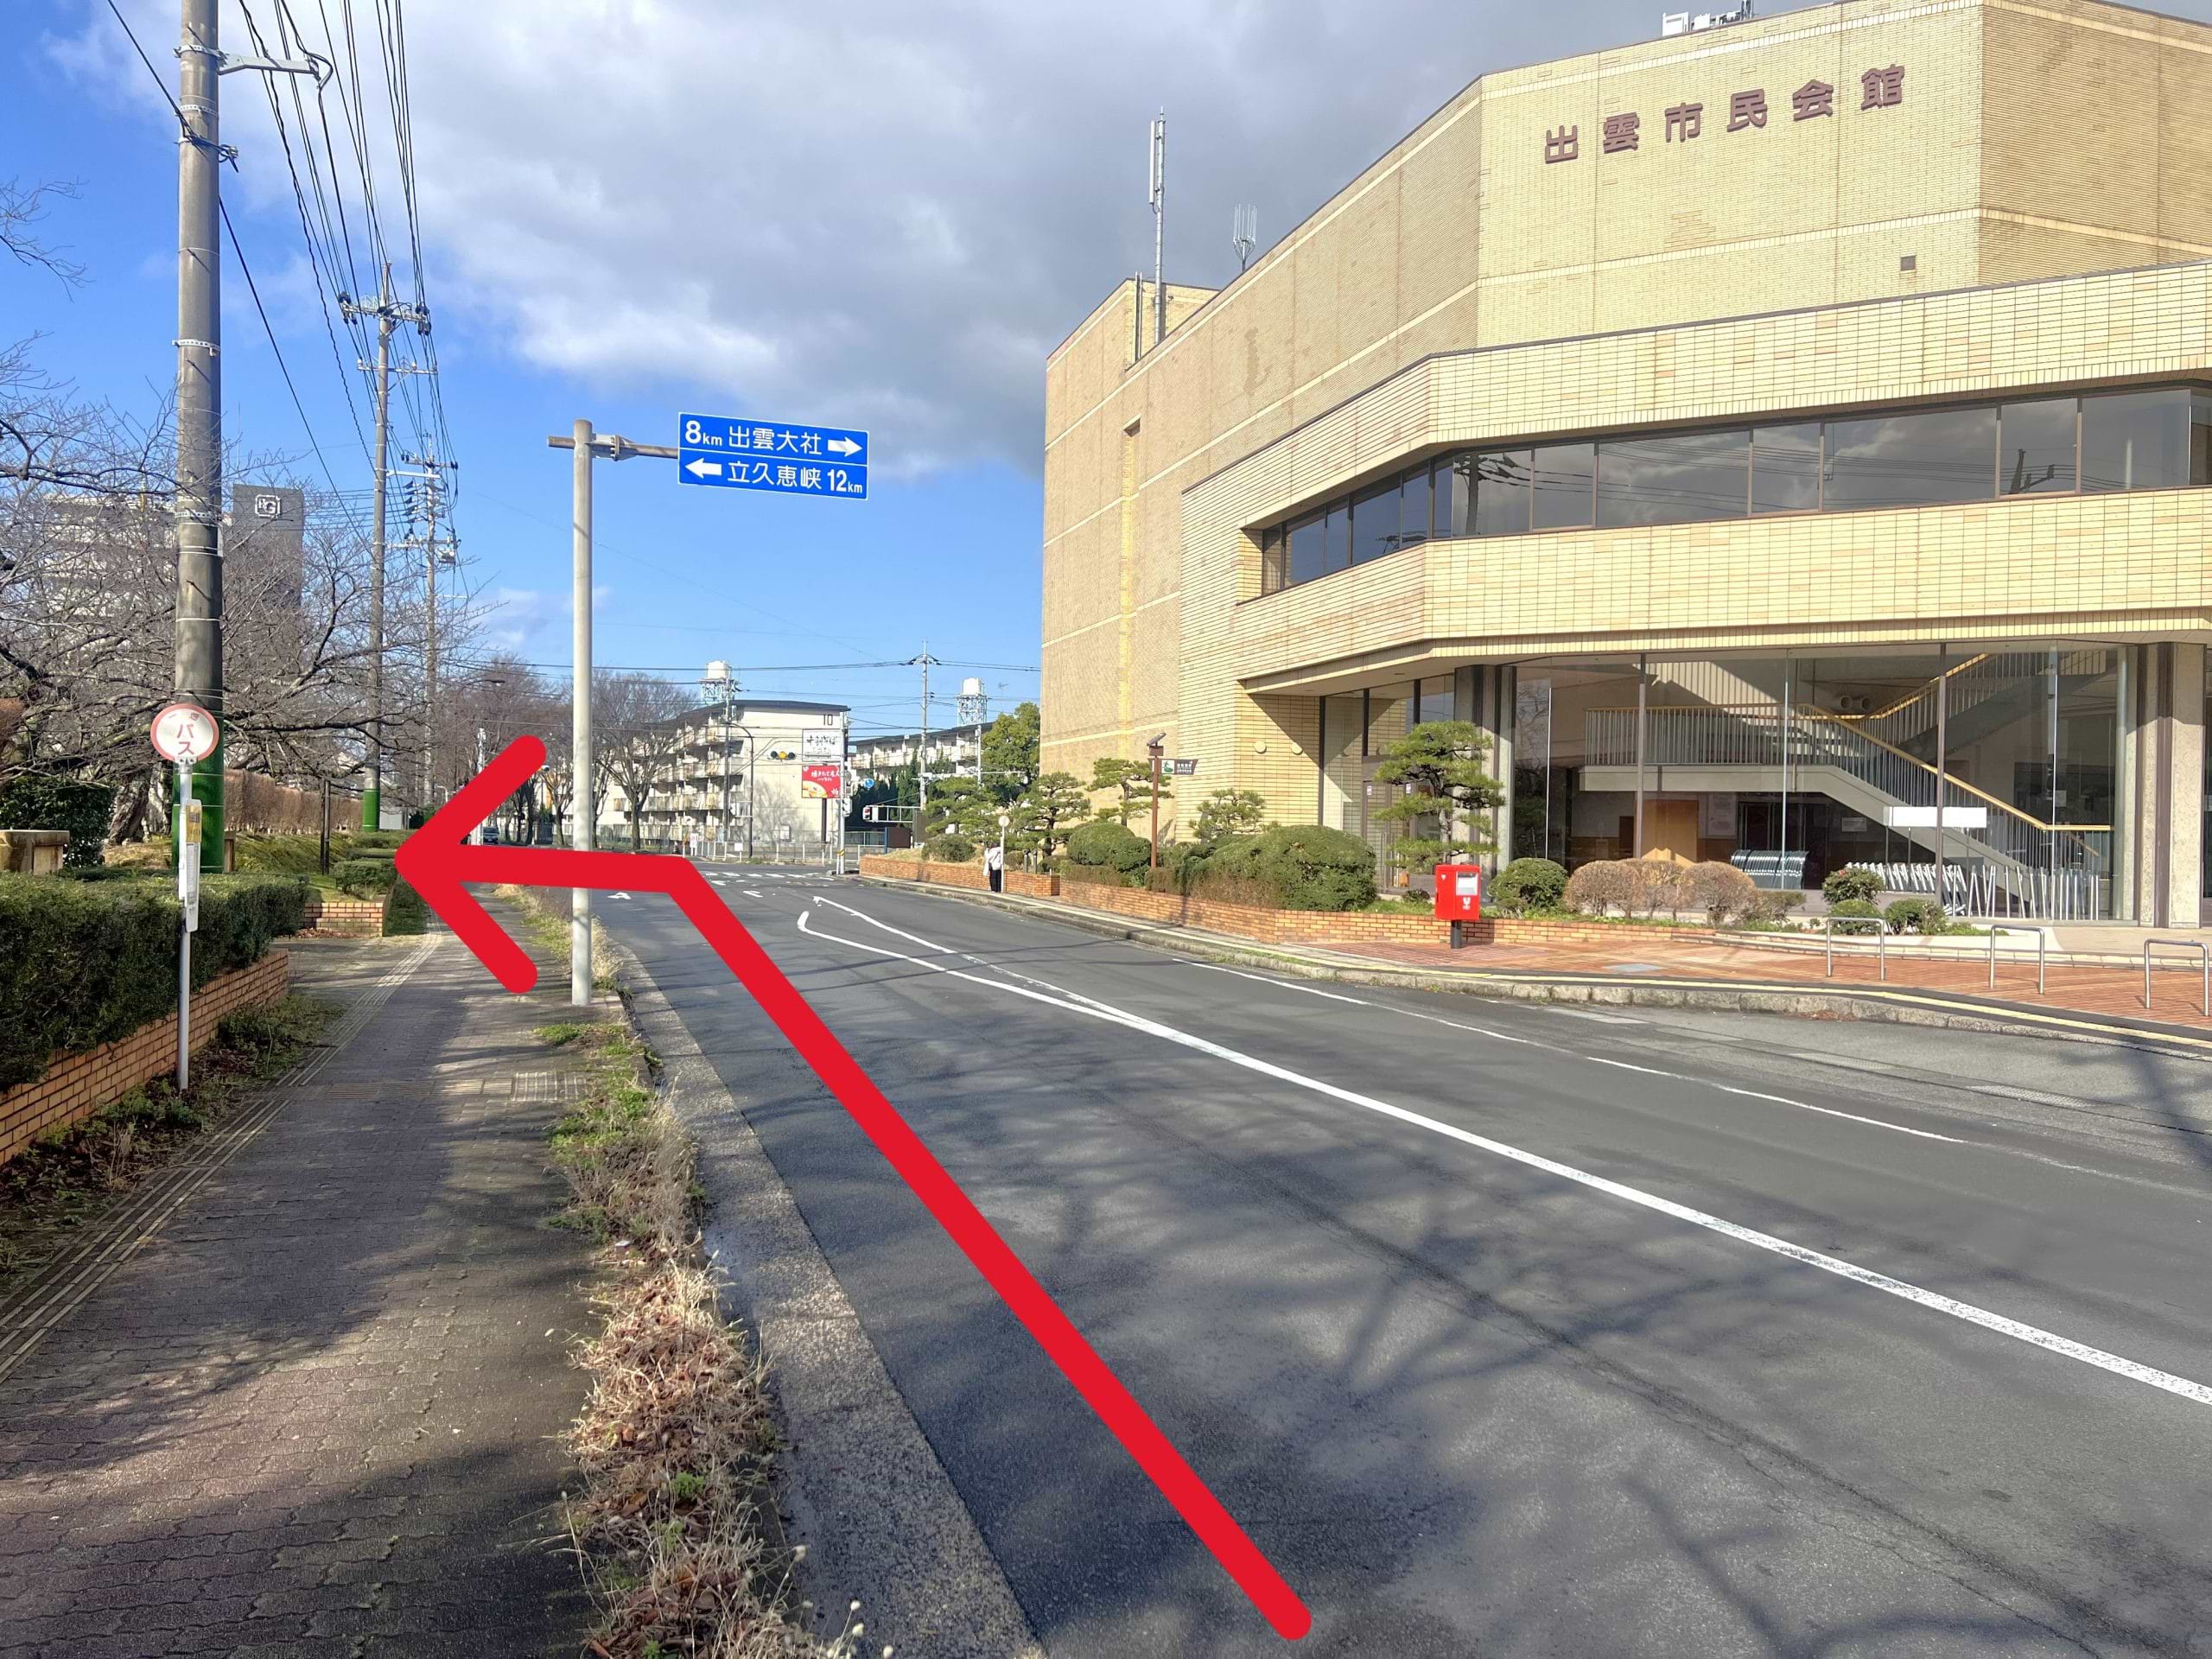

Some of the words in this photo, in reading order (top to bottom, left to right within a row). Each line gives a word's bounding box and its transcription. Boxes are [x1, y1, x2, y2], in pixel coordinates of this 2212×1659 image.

[1545, 64, 1905, 164] 出雲市民会館
[728, 425, 822, 454] 出雲大社
[728, 461, 822, 490] 立久恵峡
[823, 714, 833, 725] 10
[176, 724, 194, 755] バス
